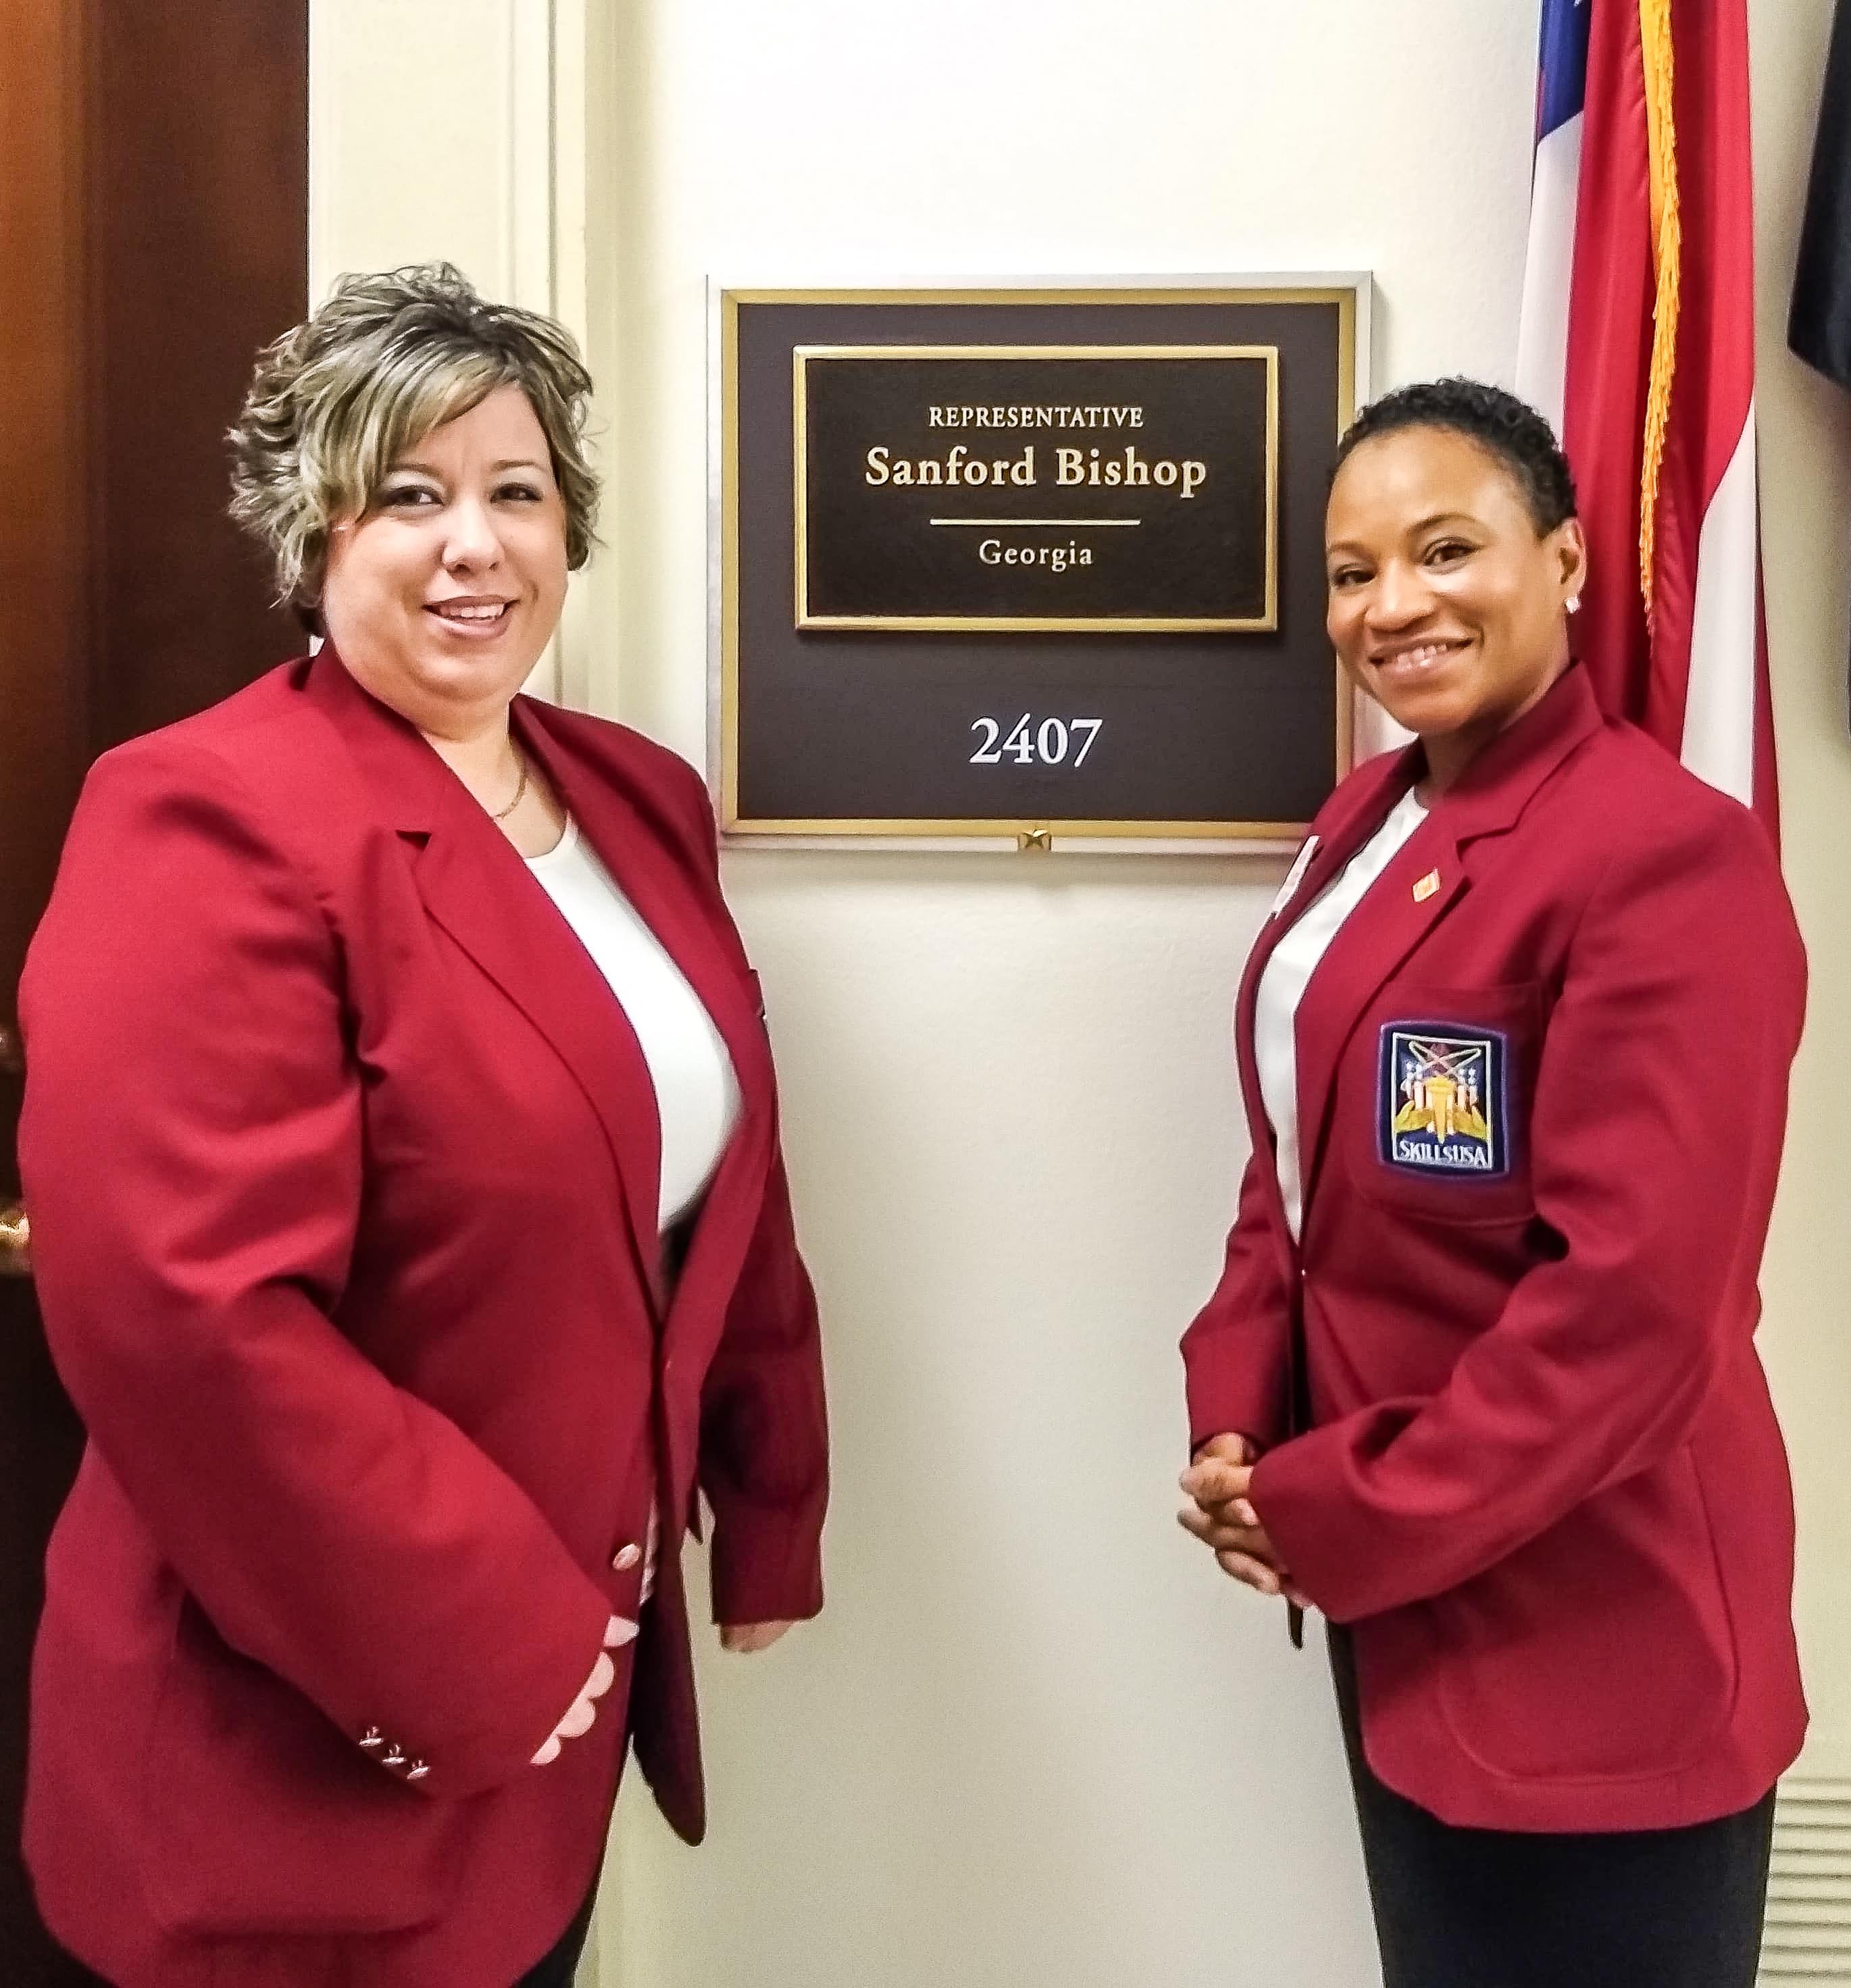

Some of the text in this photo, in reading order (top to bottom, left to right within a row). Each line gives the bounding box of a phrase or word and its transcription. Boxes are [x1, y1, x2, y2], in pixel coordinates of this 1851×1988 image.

[929, 406, 1144, 428] REPRESENTATIVE
[865, 446, 1207, 499] Sanford Bishop
[979, 540, 1094, 571] Georgia
[968, 713, 1104, 767] 2407
[1399, 1140, 1488, 1167] SKILLSUSA
